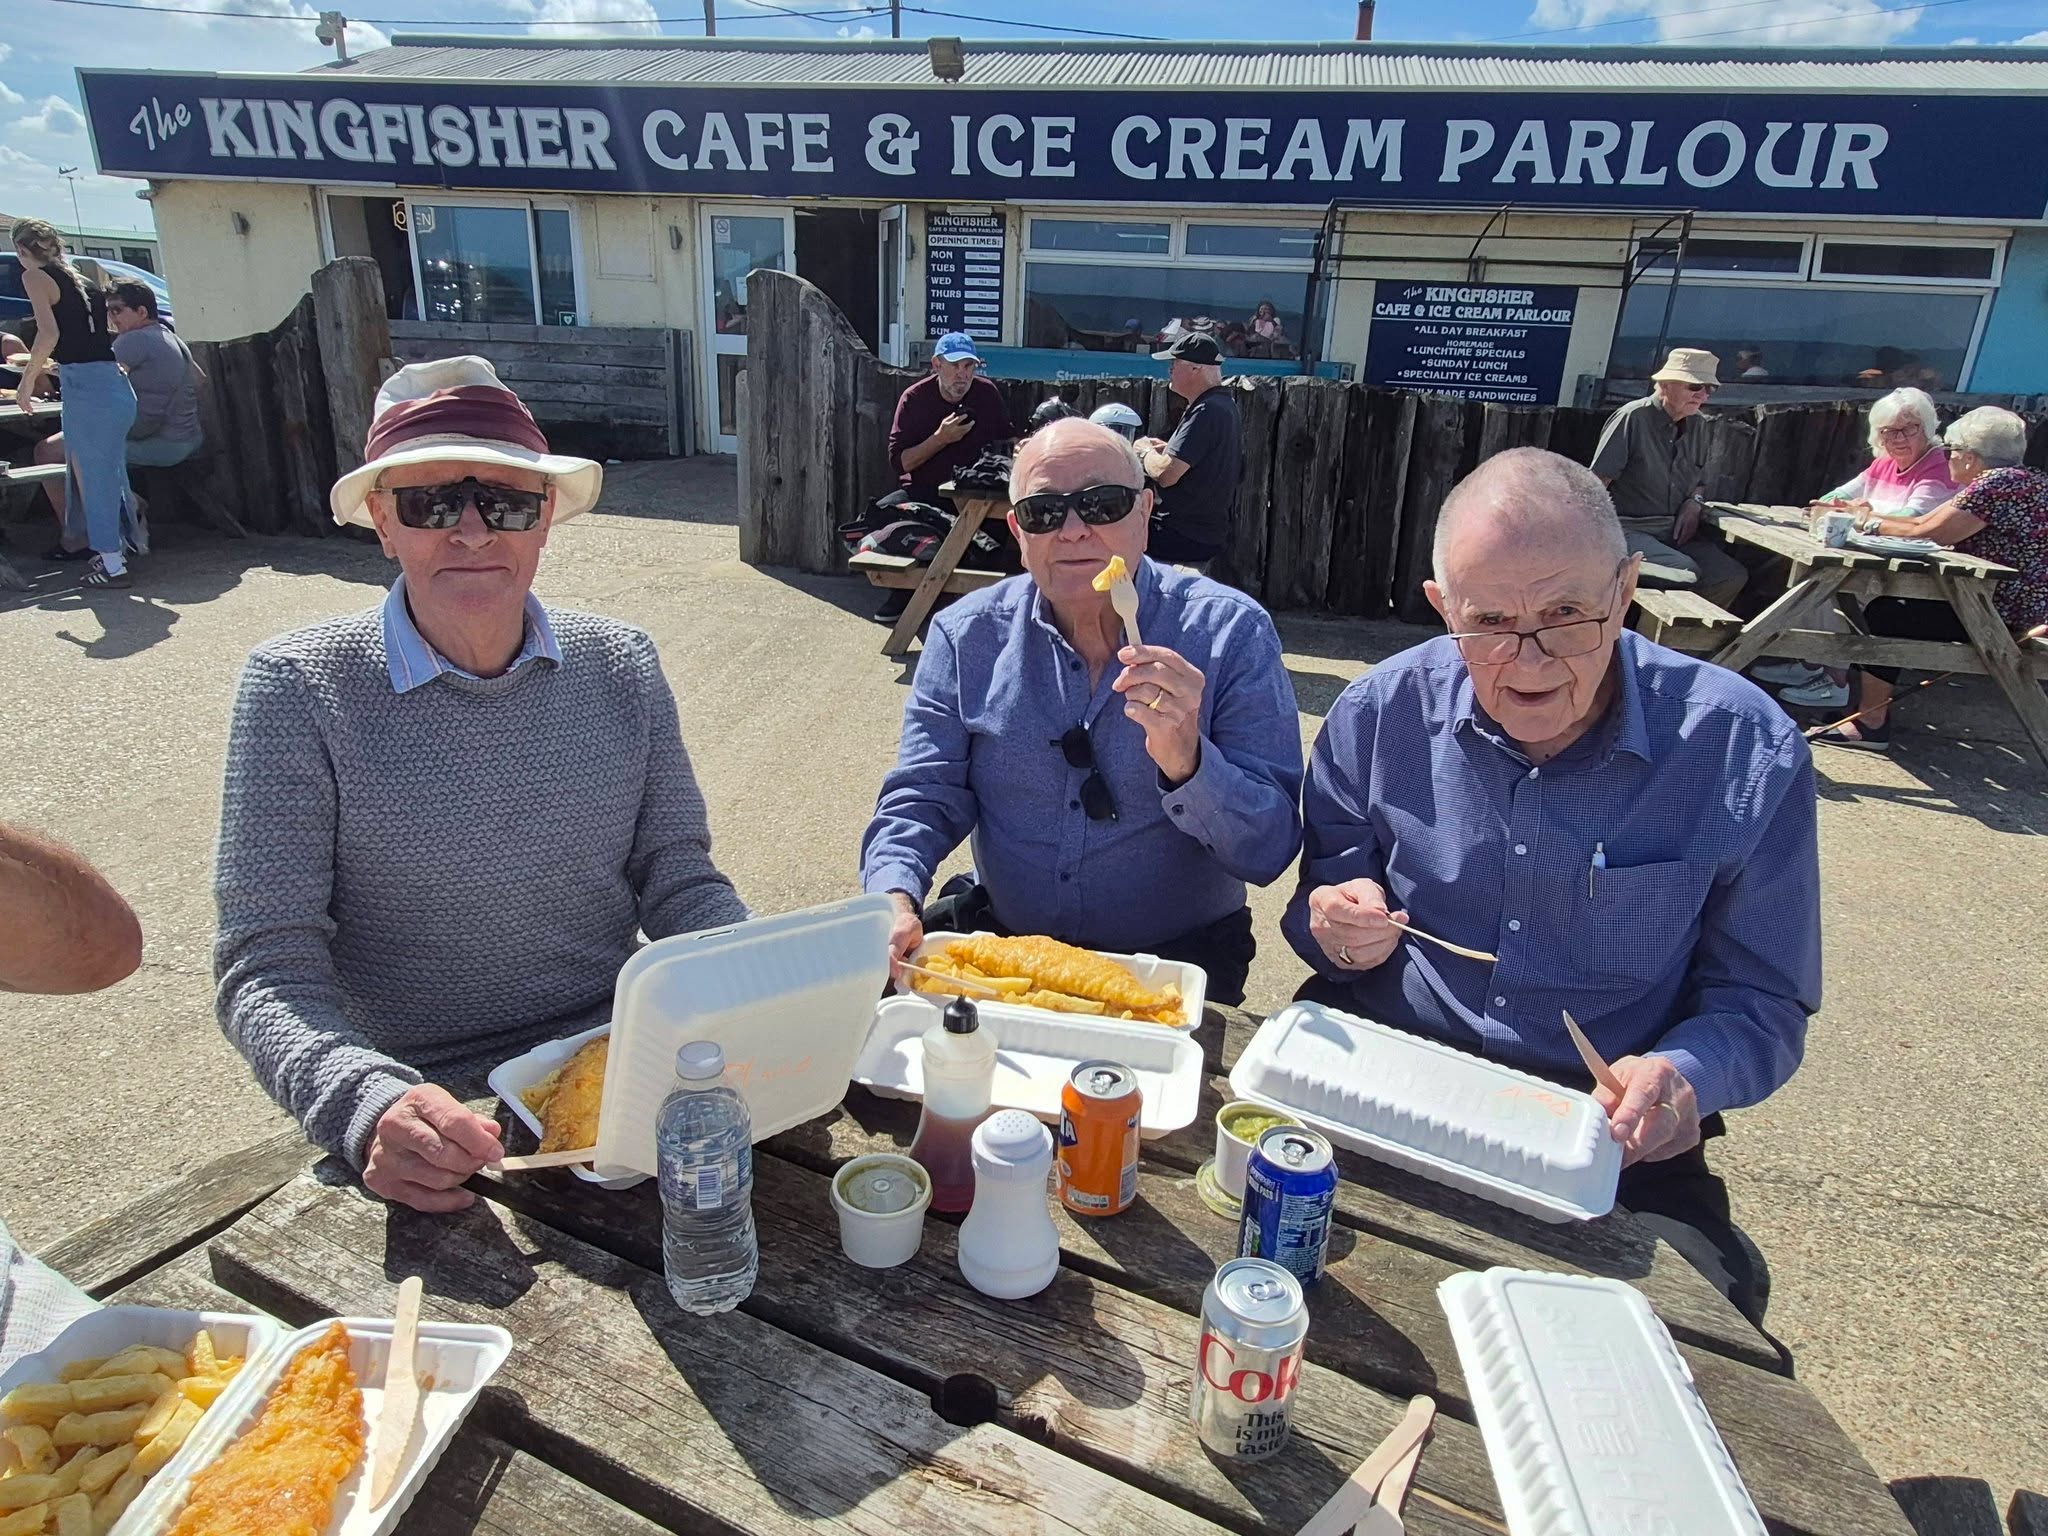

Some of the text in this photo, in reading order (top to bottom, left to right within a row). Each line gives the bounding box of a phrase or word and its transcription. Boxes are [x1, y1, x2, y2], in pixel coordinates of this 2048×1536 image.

[129, 97, 1890, 190] The KINGFISHER CAFE & ICE CREAM PARLOUR
[397, 211, 431, 226] OEN
[933, 216, 998, 227] KINGFISHER
[930, 236, 1000, 246] OPENING TIMES:
[930, 250, 953, 259] MON
[931, 263, 956, 272] TUES
[931, 276, 952, 285] WED
[931, 289, 962, 298] THURS
[1403, 286, 1535, 305] The KINGFISHER
[931, 302, 945, 311] FRI
[1375, 303, 1572, 322] CAFE & ICE CREAM PARLOUR
[930, 314, 949, 323] SAT
[930, 327, 950, 335] SUN
[1419, 325, 1528, 338] ALL DAY BREAKFAST
[1446, 340, 1495, 348] HOMEMADE
[1412, 345, 1526, 359] LUNCHTIME SPECIALS
[1427, 359, 1508, 371] SUNDAY LUNCH
[1403, 370, 1529, 384] SPECIALITY ICE CREAMS
[1468, 390, 1537, 402] SANDWICHES
[1200, 1332, 1302, 1403] Cok
[1236, 1425, 1253, 1441] is
